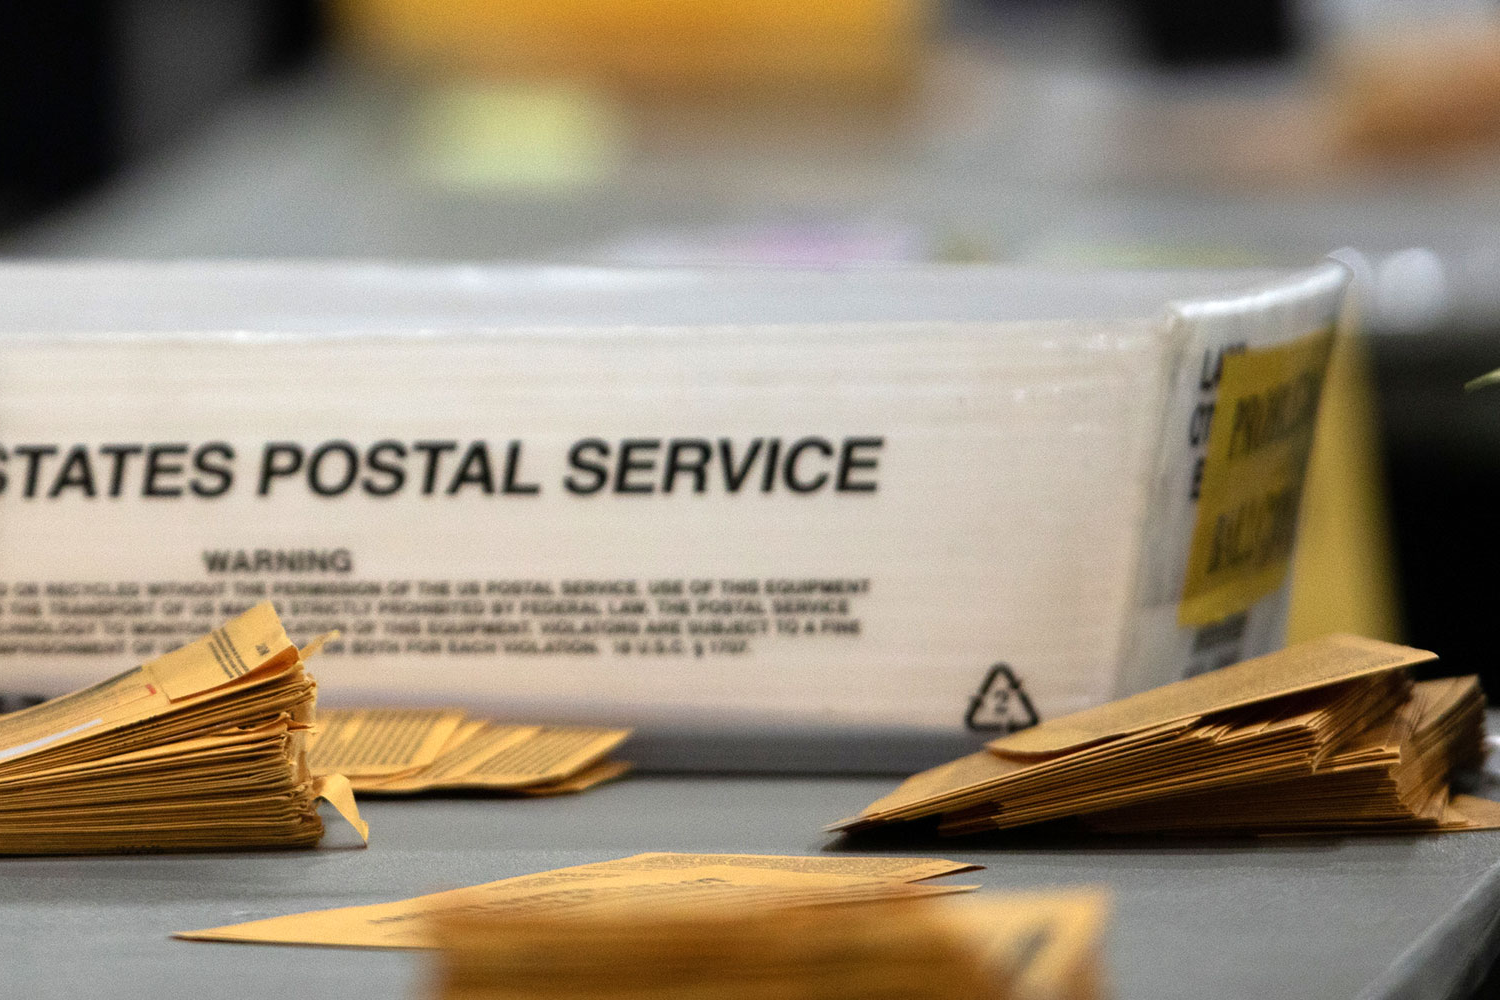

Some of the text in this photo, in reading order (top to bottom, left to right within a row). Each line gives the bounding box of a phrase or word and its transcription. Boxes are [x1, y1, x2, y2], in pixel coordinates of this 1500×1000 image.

[257, 440, 540, 498] POSTAL
[563, 437, 884, 496] SERVICE
[203, 548, 353, 575] WARNING
